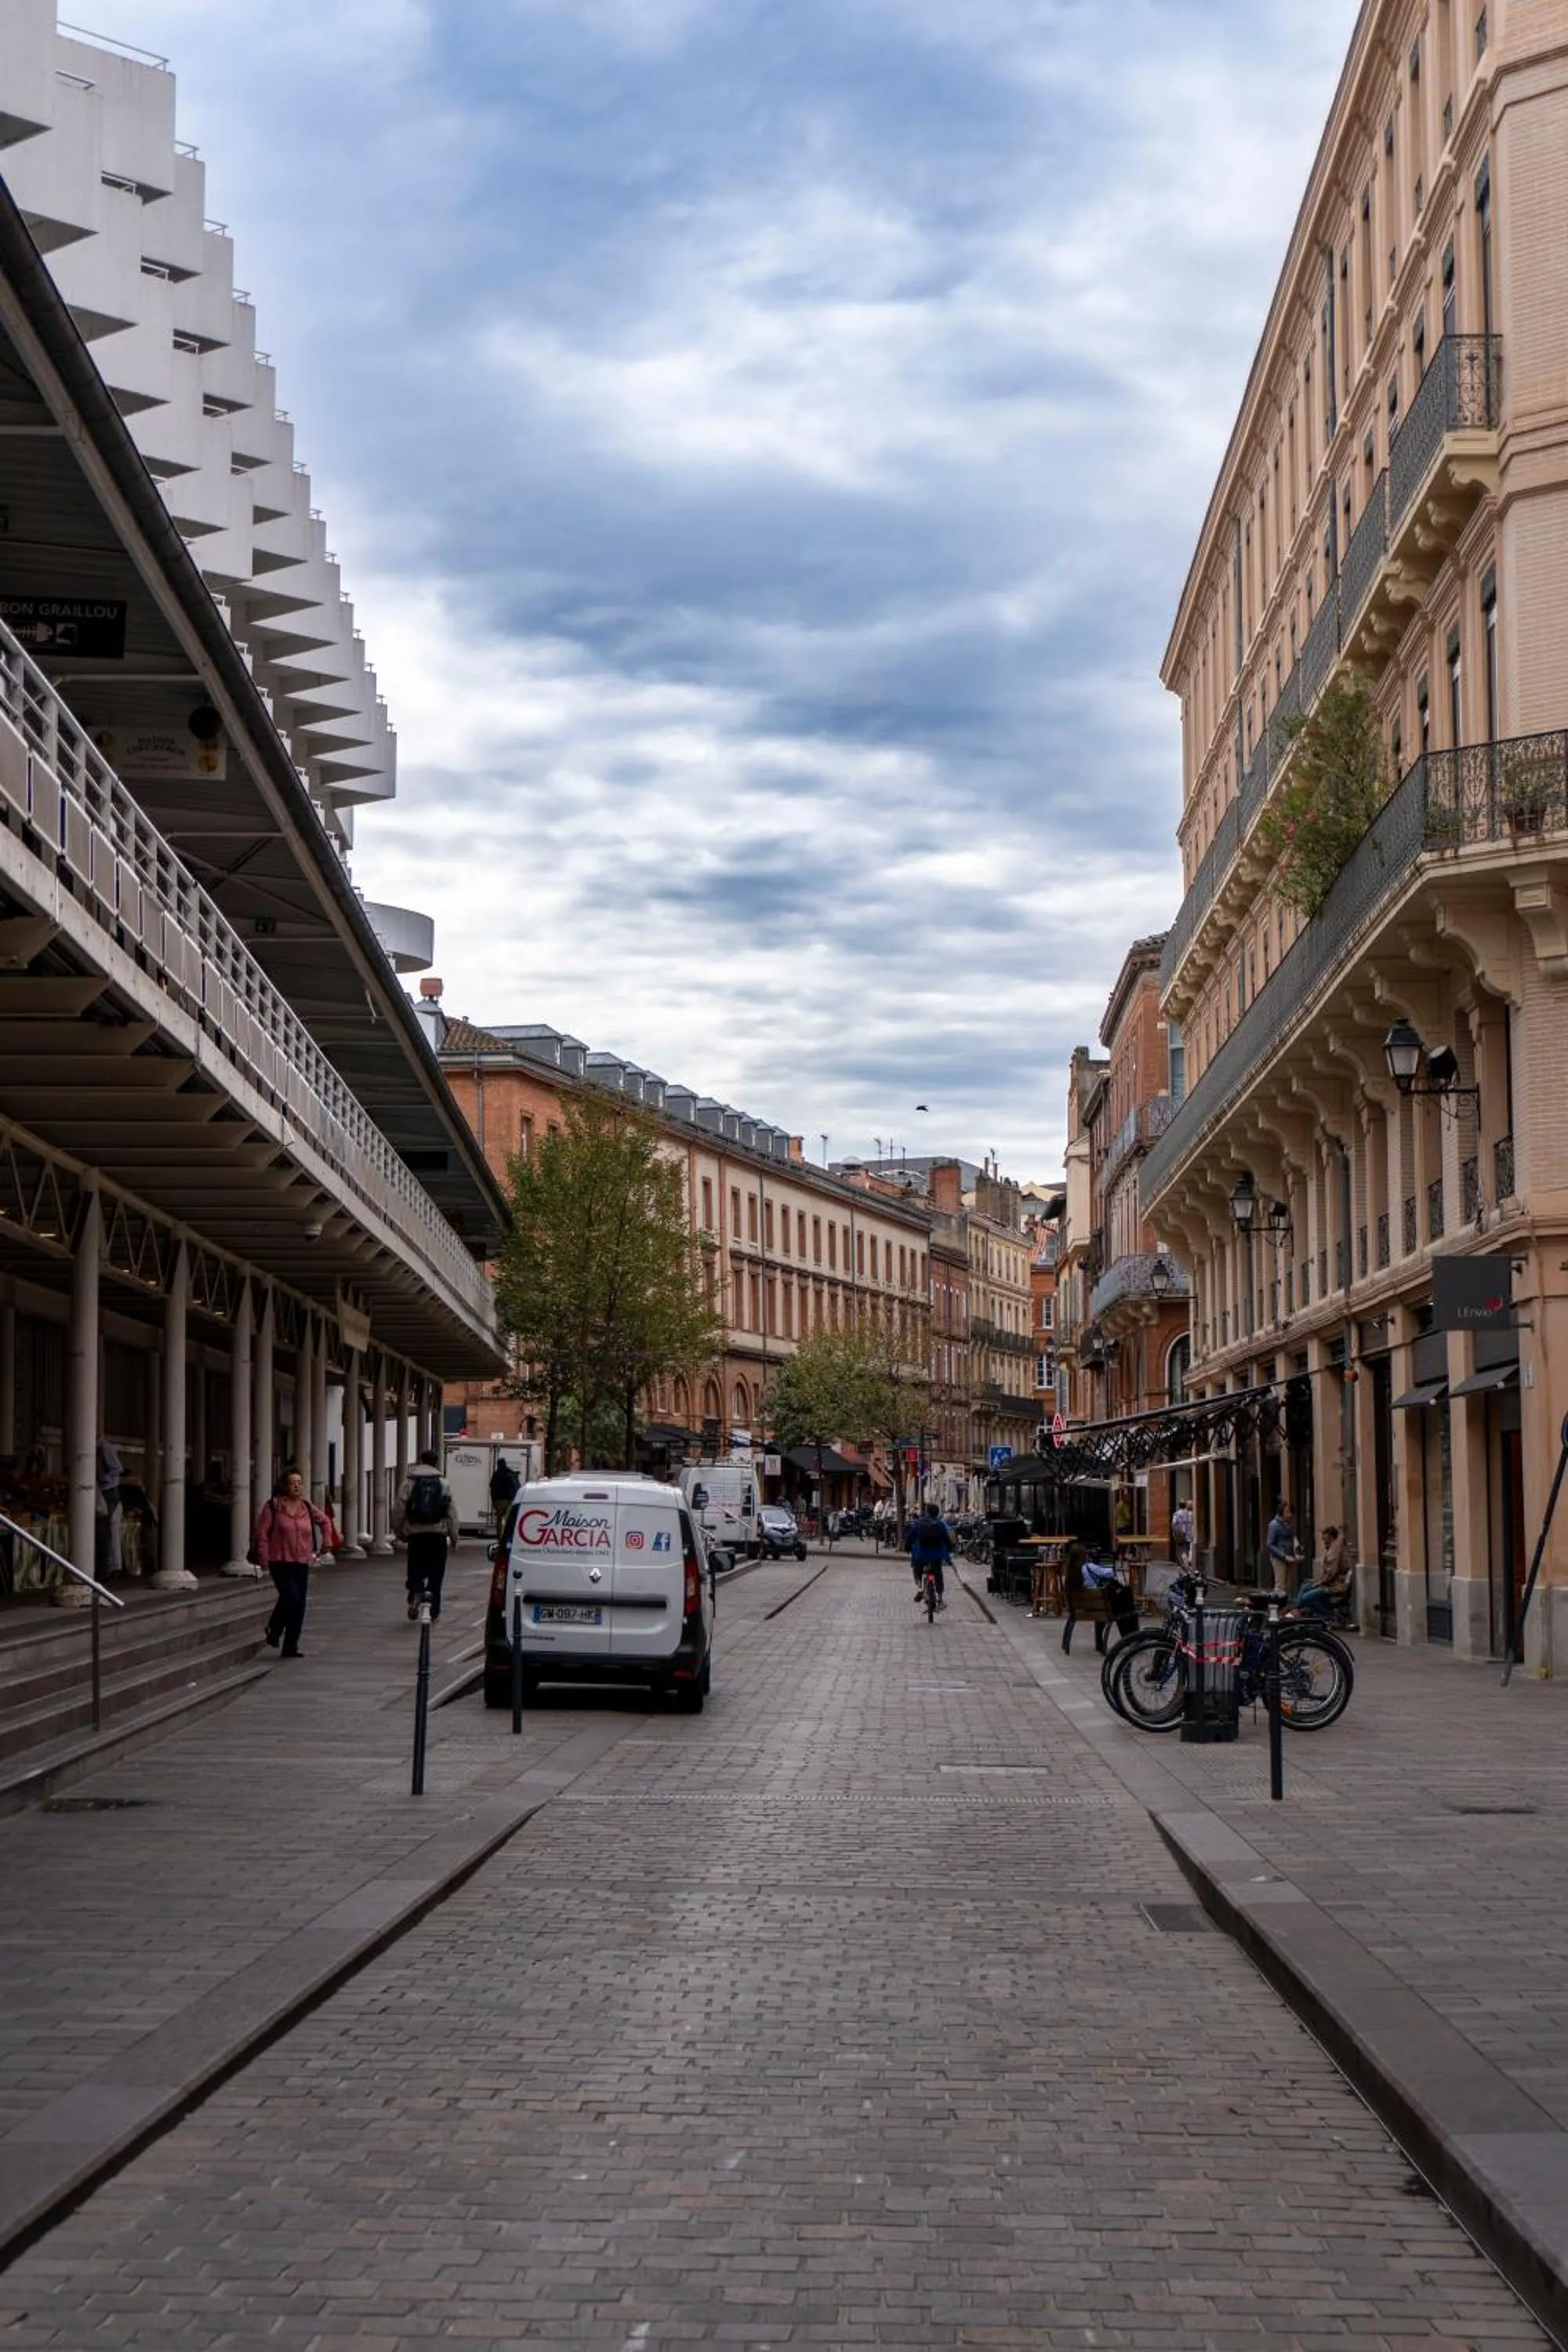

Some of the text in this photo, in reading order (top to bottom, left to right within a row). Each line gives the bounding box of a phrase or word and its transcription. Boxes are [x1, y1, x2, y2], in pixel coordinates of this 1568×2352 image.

[38, 602, 118, 619] GRAILLOU
[517, 1510, 611, 1547] GARCIA
[539, 1509, 612, 1529] Maison
